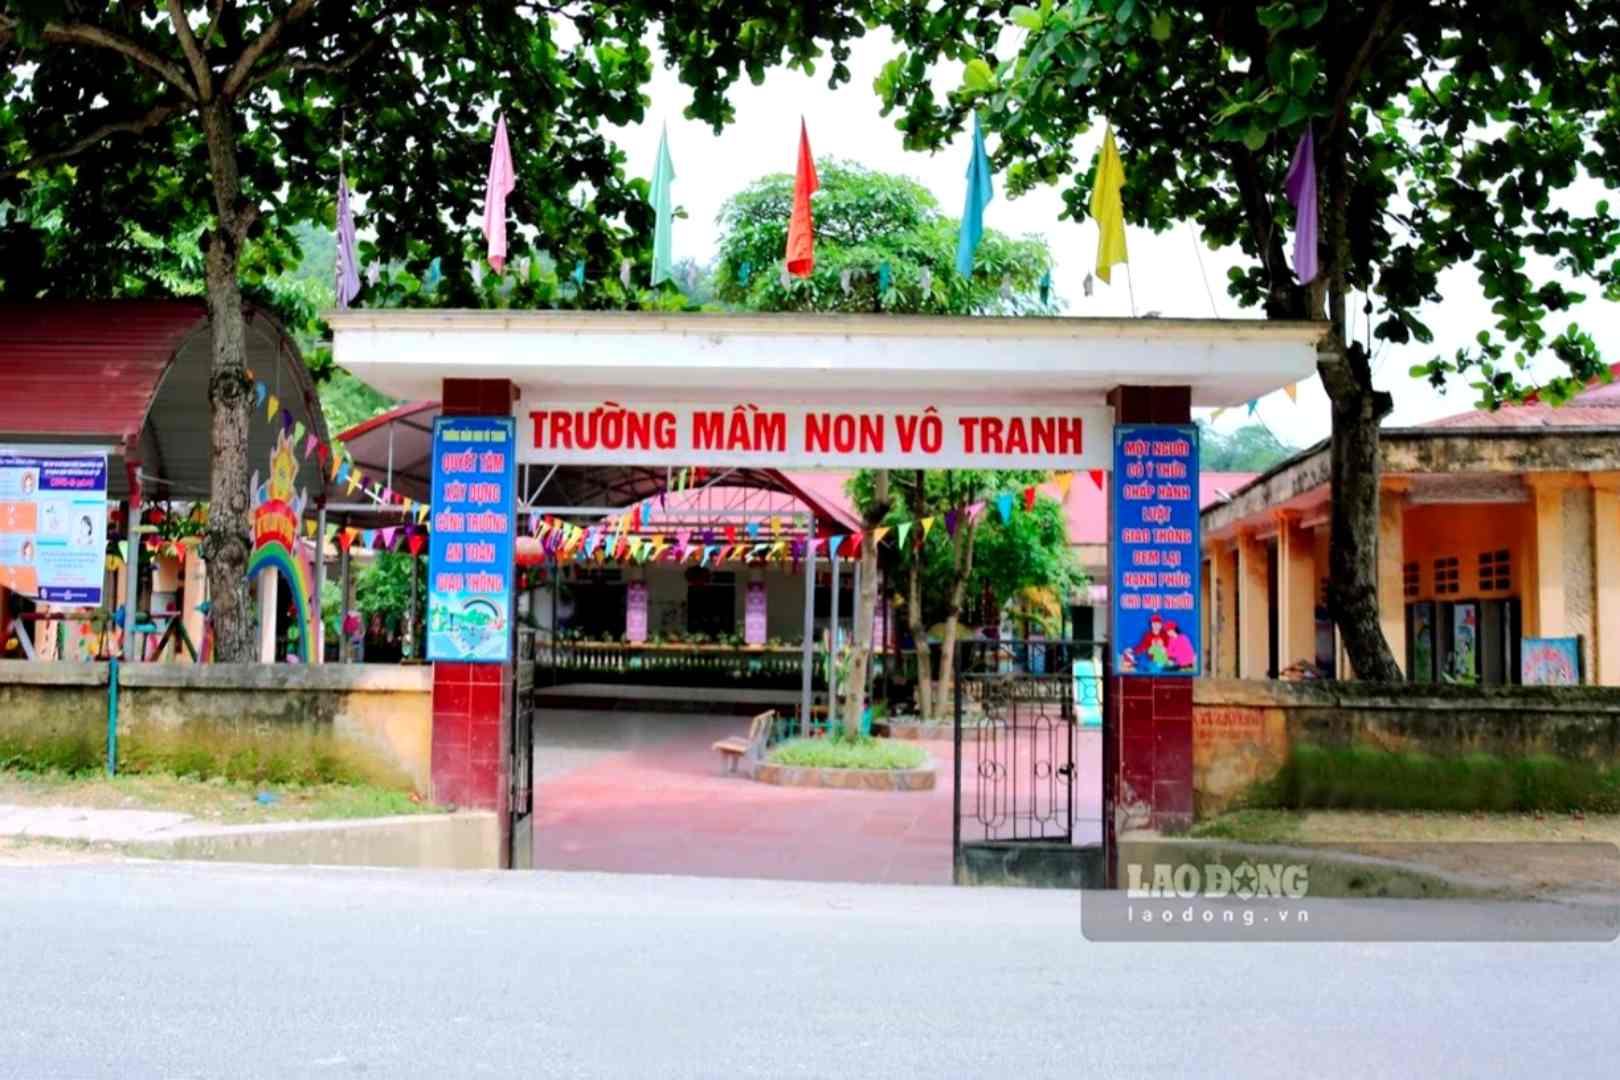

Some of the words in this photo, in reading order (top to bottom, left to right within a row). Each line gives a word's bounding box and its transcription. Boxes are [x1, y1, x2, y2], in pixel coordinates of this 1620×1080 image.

[529, 401, 677, 450] TRƯỜNG
[692, 404, 786, 452] MẦM
[804, 413, 885, 453] NON
[895, 405, 944, 453] VÔ
[958, 416, 1084, 455] TRANH
[1124, 438, 1150, 459] MỘT
[442, 447, 476, 474] QUYẾT
[480, 450, 504, 473] TÂM
[1123, 480, 1155, 500] CHẤP
[1142, 504, 1172, 525] LUẬT
[1122, 528, 1150, 544] GIAO
[1152, 526, 1192, 544] THÔNG
[446, 543, 463, 562] AN
